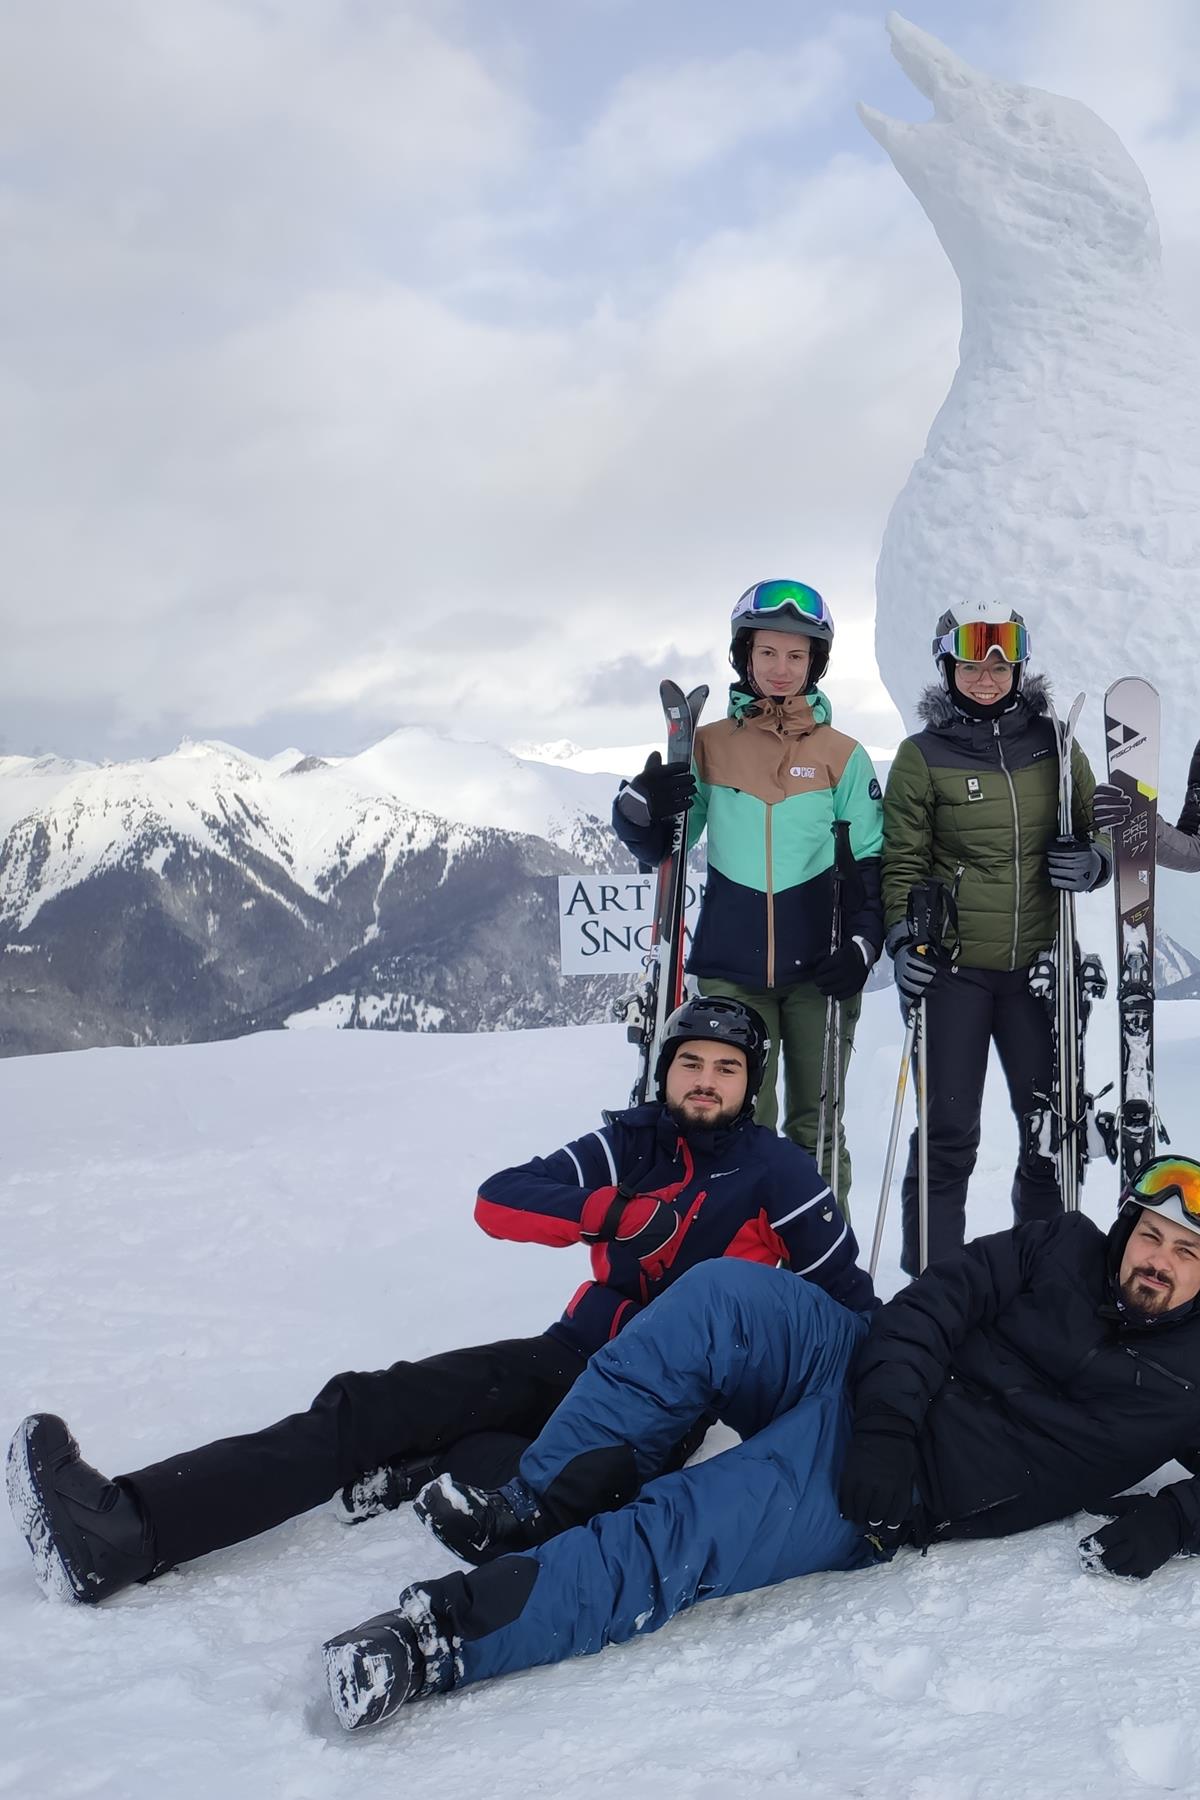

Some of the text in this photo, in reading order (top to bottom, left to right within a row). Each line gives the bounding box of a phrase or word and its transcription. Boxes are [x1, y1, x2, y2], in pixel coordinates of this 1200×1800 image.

[1109, 736, 1147, 762] FISCHER
[1122, 819, 1148, 840] PRO
[1123, 827, 1148, 848] MTN
[1131, 840, 1148, 858] 77
[564, 880, 651, 916] ART
[1131, 905, 1150, 923] 157
